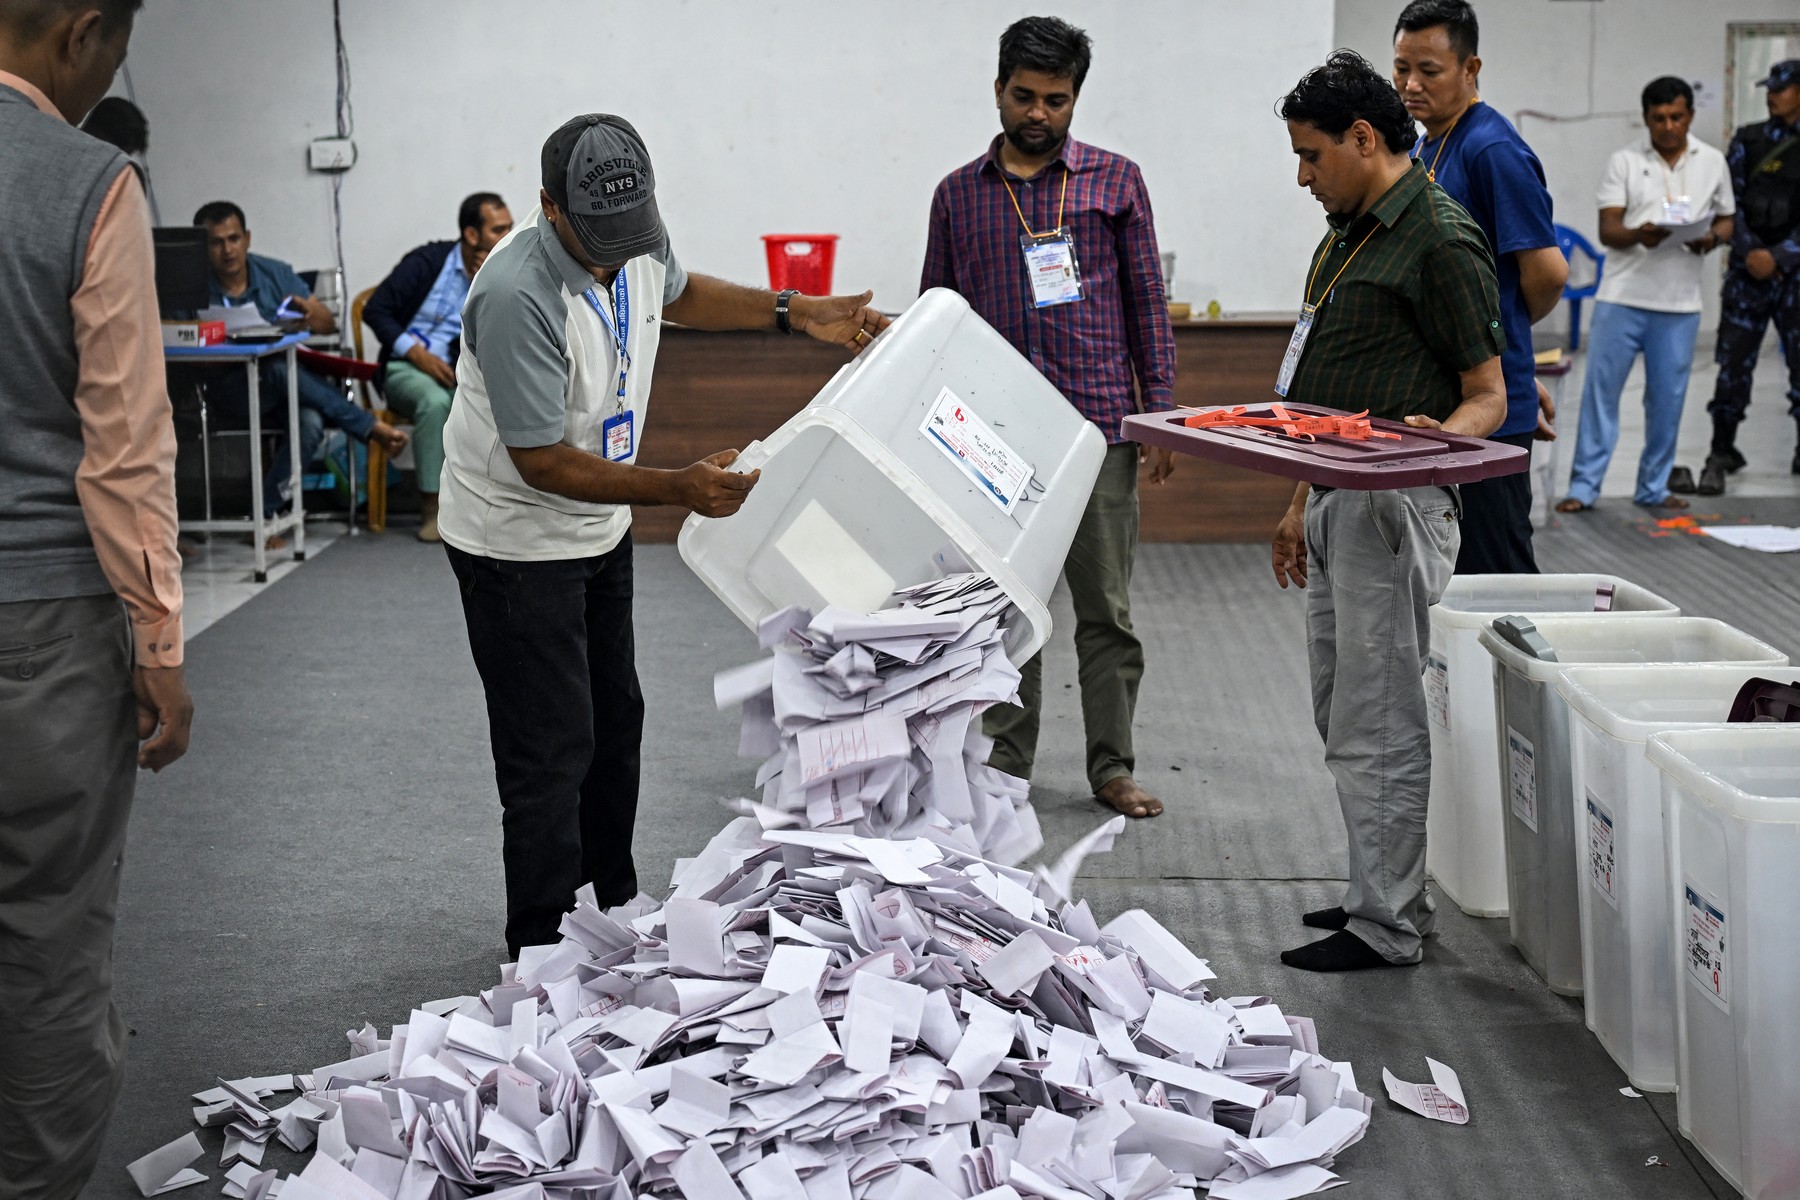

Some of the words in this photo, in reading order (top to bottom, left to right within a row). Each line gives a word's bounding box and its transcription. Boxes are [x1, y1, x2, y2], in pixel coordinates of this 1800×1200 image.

[579, 158, 647, 191] BROSVILLE
[604, 176, 634, 193] NYS
[607, 189, 648, 209] FORWARD
